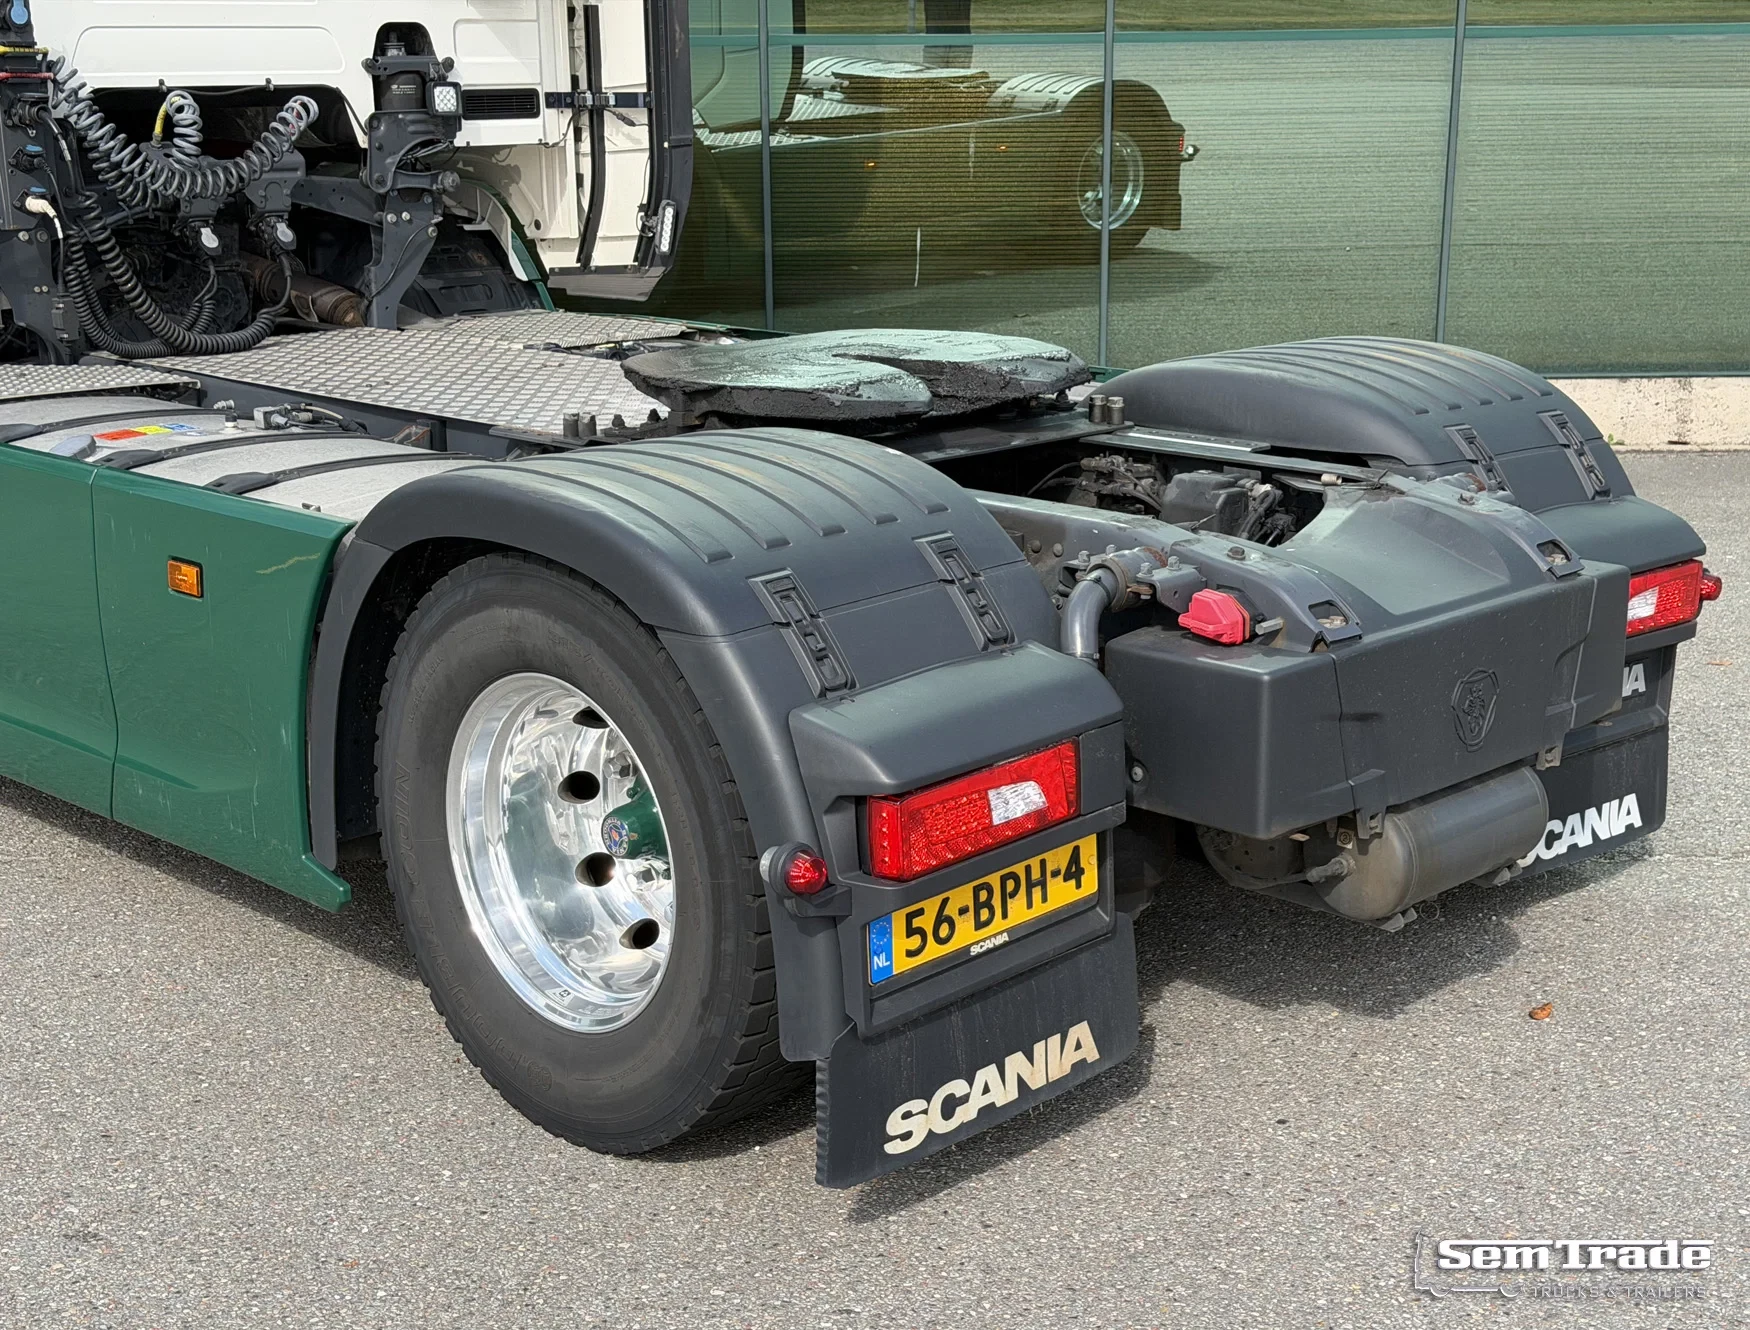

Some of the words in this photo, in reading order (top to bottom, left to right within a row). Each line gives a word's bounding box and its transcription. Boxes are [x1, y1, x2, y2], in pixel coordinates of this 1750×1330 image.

[904, 844, 1085, 959] 56-BPH-4
[873, 954, 891, 970] NL
[969, 932, 1010, 956] SCANIA
[883, 1020, 1100, 1155] SCANIA
